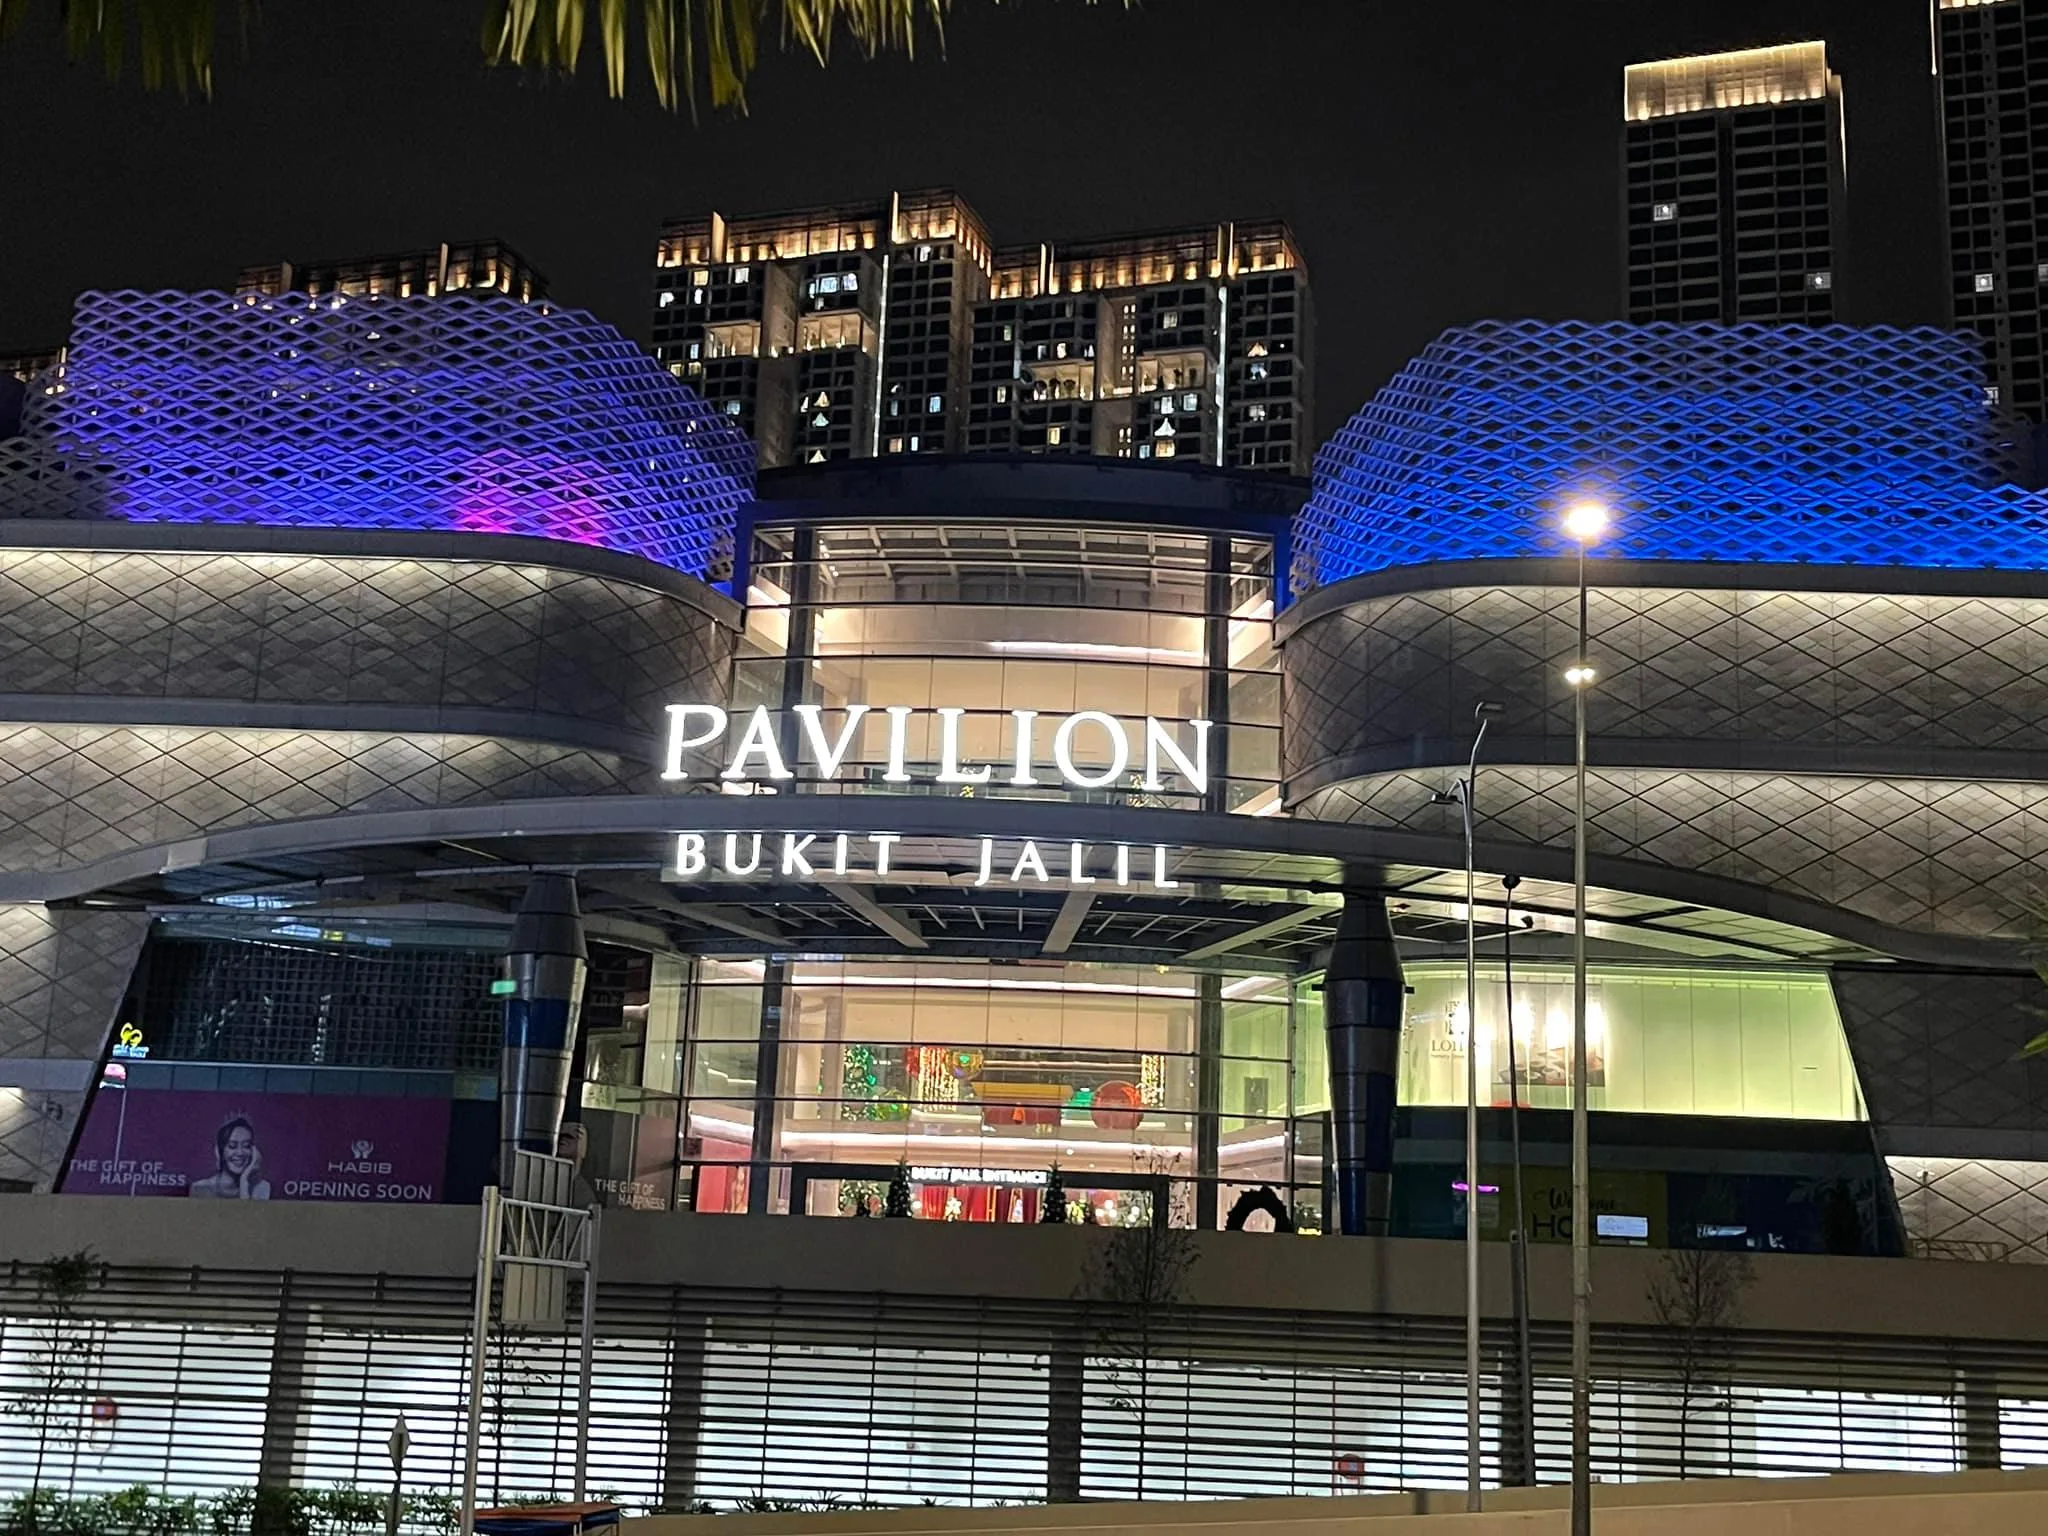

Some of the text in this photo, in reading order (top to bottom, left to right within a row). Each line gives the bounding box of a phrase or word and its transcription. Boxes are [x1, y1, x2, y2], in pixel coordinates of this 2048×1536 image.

[660, 703, 1214, 794] PAVILION
[675, 833, 1179, 888] BUKIT JALIL
[70, 1159, 165, 1173] THE GIFT OF
[327, 1160, 392, 1175] HABIB
[100, 1172, 187, 1186] HAPPINESS
[594, 1178, 617, 1193] THE
[284, 1180, 433, 1200] OPENING SOON
